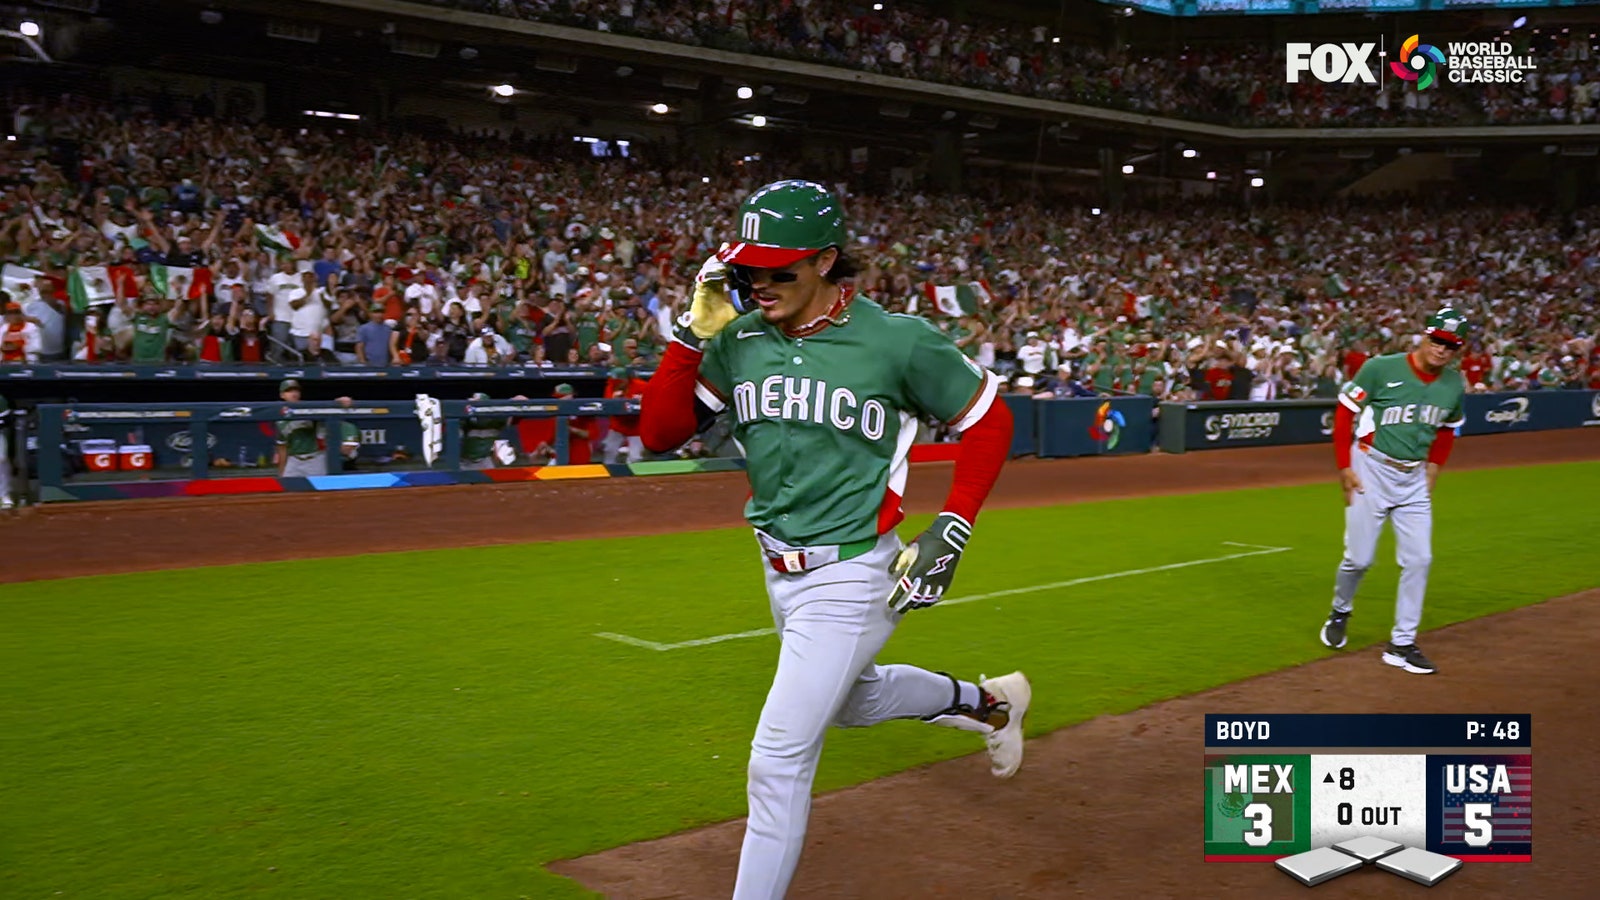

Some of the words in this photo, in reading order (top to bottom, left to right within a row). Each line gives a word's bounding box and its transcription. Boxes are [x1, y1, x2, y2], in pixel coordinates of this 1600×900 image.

[733, 374, 885, 441] MEXICO
[95, 454, 110, 467] G
[130, 453, 145, 467] G
